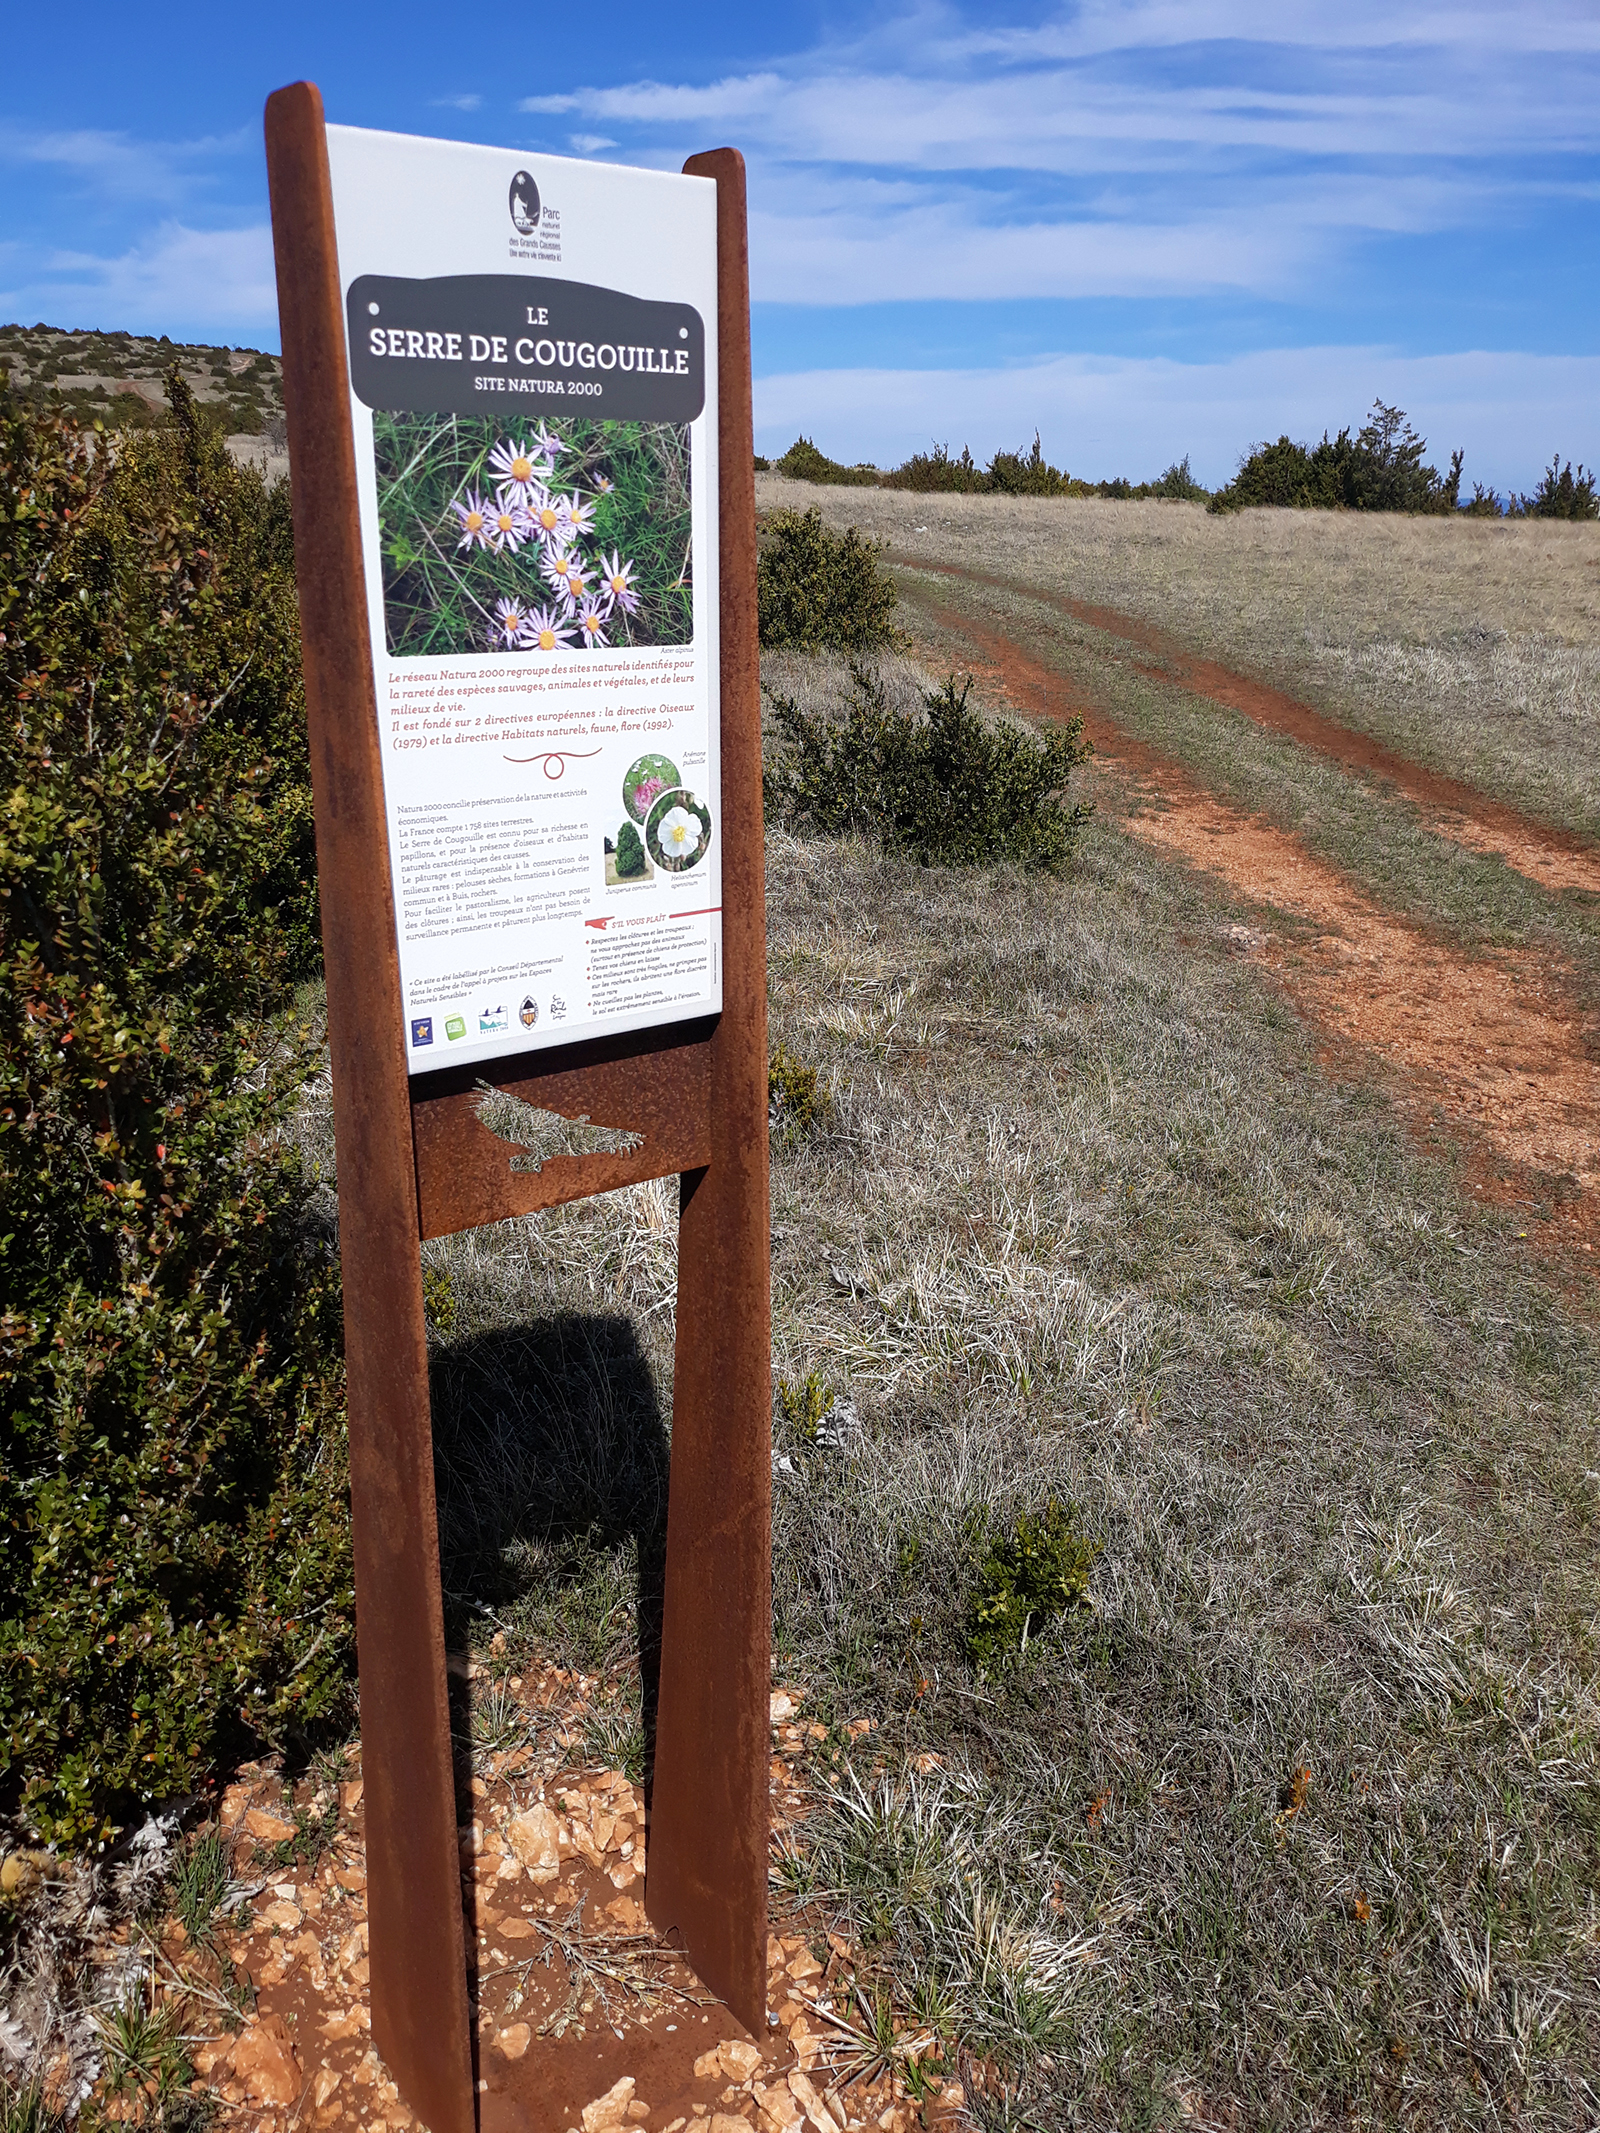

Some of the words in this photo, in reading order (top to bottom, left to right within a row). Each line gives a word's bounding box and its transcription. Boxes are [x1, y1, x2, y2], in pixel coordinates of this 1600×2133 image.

[541, 221, 560, 229] naturel
[542, 206, 560, 220] Parc
[508, 237, 519, 246] des
[519, 237, 538, 248] Grands
[539, 239, 561, 250] Causses
[539, 230, 560, 239] régional
[526, 306, 548, 325] LE
[369, 327, 462, 360] SERRE
[469, 334, 507, 363] DE
[514, 338, 688, 374] COUGOUILLE
[474, 376, 505, 391] SITE
[507, 378, 565, 394] NATURA
[567, 381, 602, 396] 2000
[388, 672, 400, 683] Le
[402, 671, 437, 682] réseau
[439, 670, 476, 680] Natura
[478, 668, 505, 678] 2000
[506, 667, 549, 678] regroupe
[550, 663, 567, 674] des
[568, 663, 590, 673] sites
[592, 660, 630, 672] naturels
[631, 658, 672, 670] identifiés
[673, 660, 694, 670] pour
[389, 688, 399, 699] la
[402, 686, 435, 698] rareté
[436, 685, 454, 696] des
[456, 684, 495, 697] espèces
[497, 683, 545, 693] sauvages,
[547, 677, 591, 689] animales
[592, 679, 602, 687] et
[603, 674, 648, 688] végétales,
[650, 676, 659, 684] et
[660, 673, 671, 683] de
[672, 672, 694, 683] leurs
[390, 703, 430, 715] milieux
[432, 701, 445, 712] de
[447, 702, 465, 711] vie.
[391, 720, 399, 731] Il
[403, 721, 419, 730] est
[422, 717, 451, 729] fondé
[454, 719, 471, 727] sur
[474, 717, 481, 725] 2
[484, 713, 533, 725] directives
[536, 709, 595, 722] européennes
[604, 706, 613, 716] la
[616, 705, 656, 716] directive
[658, 703, 694, 713] Oiseaux
[392, 735, 427, 750] (1979)
[429, 737, 439, 745] et
[441, 733, 451, 744] la
[454, 731, 499, 743] directive
[501, 728, 544, 740] Habitats
[546, 723, 588, 736] naturels,
[590, 722, 618, 733] faune,
[620, 720, 640, 731] flore
[642, 718, 673, 731] (1992).
[396, 805, 423, 814] Natura
[423, 803, 442, 811] 2000
[442, 799, 470, 809] concilie
[471, 795, 514, 808] préservation
[514, 793, 523, 802] de
[559, 788, 587, 797] activités
[397, 815, 448, 825] économiques.
[398, 829, 408, 837] La
[409, 827, 434, 836] France
[435, 825, 463, 833] compte
[469, 821, 481, 830] 758
[483, 820, 499, 828] sites
[500, 817, 534, 826] terrestres.
[400, 850, 436, 863] papillons,
[449, 847, 466, 857] pour
[479, 842, 510, 853] présence
[513, 838, 544, 847] d'oiseaux
[556, 832, 588, 842] d'habitats
[411, 839, 430, 848] Serre
[432, 836, 442, 845] de
[444, 832, 483, 844] Cougouille
[498, 830, 520, 838] connu
[522, 828, 539, 837] pour
[550, 823, 577, 832] richesse
[401, 861, 431, 872] naturels
[432, 856, 488, 868] caractéristiques
[489, 853, 501, 861] des
[502, 851, 530, 860] causses.
[401, 875, 411, 884] Le
[414, 873, 447, 884] pâturage
[464, 862, 512, 876] indispensable
[532, 857, 575, 867] conservation
[577, 853, 589, 861] des
[402, 885, 430, 895] milieux
[455, 879, 486, 890] pelouses
[487, 874, 512, 884] sèches,
[513, 870, 550, 881] formations
[556, 865, 589, 875] Genévrier
[403, 897, 436, 907] commun
[451, 891, 469, 900] Buis,
[470, 888, 497, 898] rochers.
[404, 910, 421, 918] Pour
[424, 905, 452, 915] faciliter
[455, 902, 462, 911] le
[465, 898, 511, 911] pastoralisme,
[513, 894, 523, 903] les
[526, 890, 565, 902] agriculteurs
[568, 887, 590, 897] posent
[404, 920, 418, 929] des
[420, 918, 449, 927] clôtures
[456, 912, 474, 922] ainsi,
[476, 911, 487, 919] les
[489, 907, 523, 917] troupeaux
[525, 904, 542, 912] n'ont
[544, 902, 556, 911] pas
[558, 898, 580, 907] besoin
[582, 895, 590, 904] de
[611, 920, 624, 928] S'IL
[625, 917, 645, 926] VOUS
[645, 912, 666, 923] PLAÎT
[405, 928, 448, 941] surveillance
[450, 923, 492, 936] permanente
[501, 917, 530, 928] pâturent
[531, 913, 545, 924] plus
